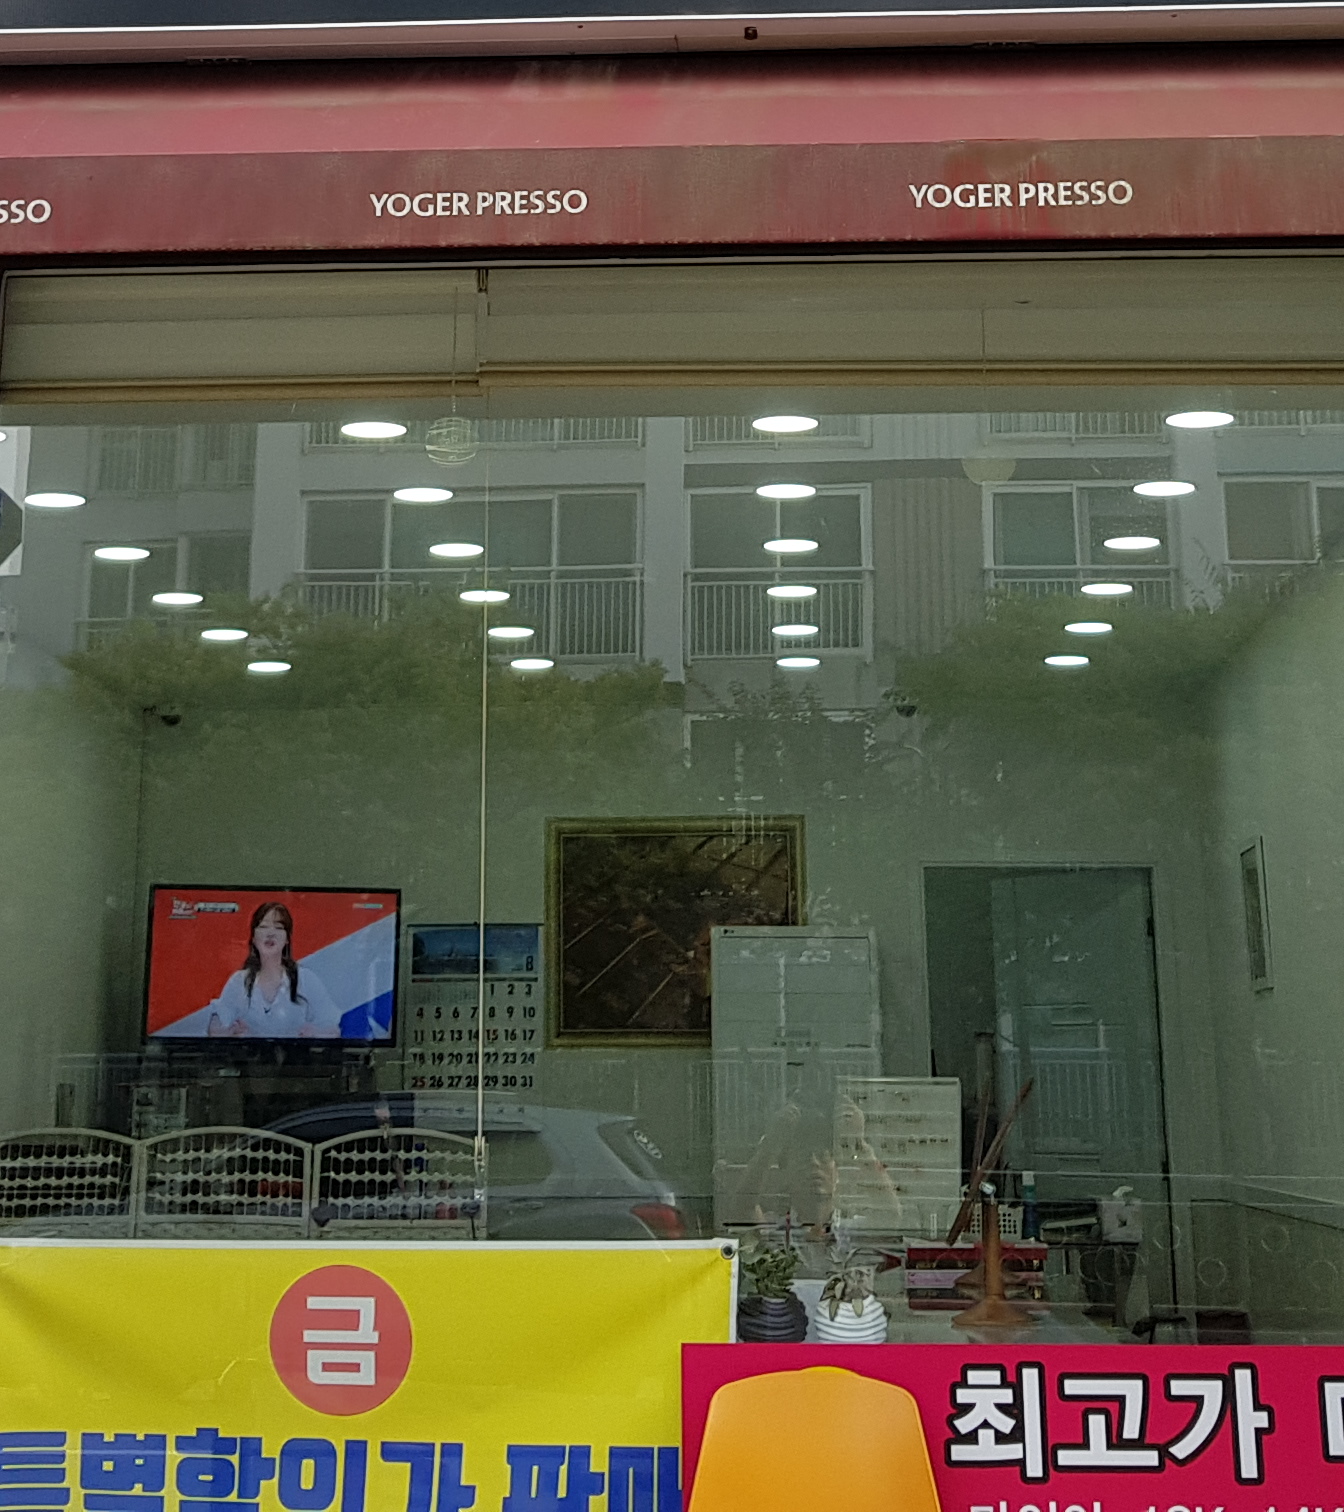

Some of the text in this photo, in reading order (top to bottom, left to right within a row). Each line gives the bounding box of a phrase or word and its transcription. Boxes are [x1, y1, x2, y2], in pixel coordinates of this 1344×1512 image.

[369, 189, 588, 218] YOGER PRESSO
[909, 180, 1134, 209] YOGER PRESSO
[302, 1295, 379, 1386] 금
[947, 1361, 1272, 1482] 최고가
